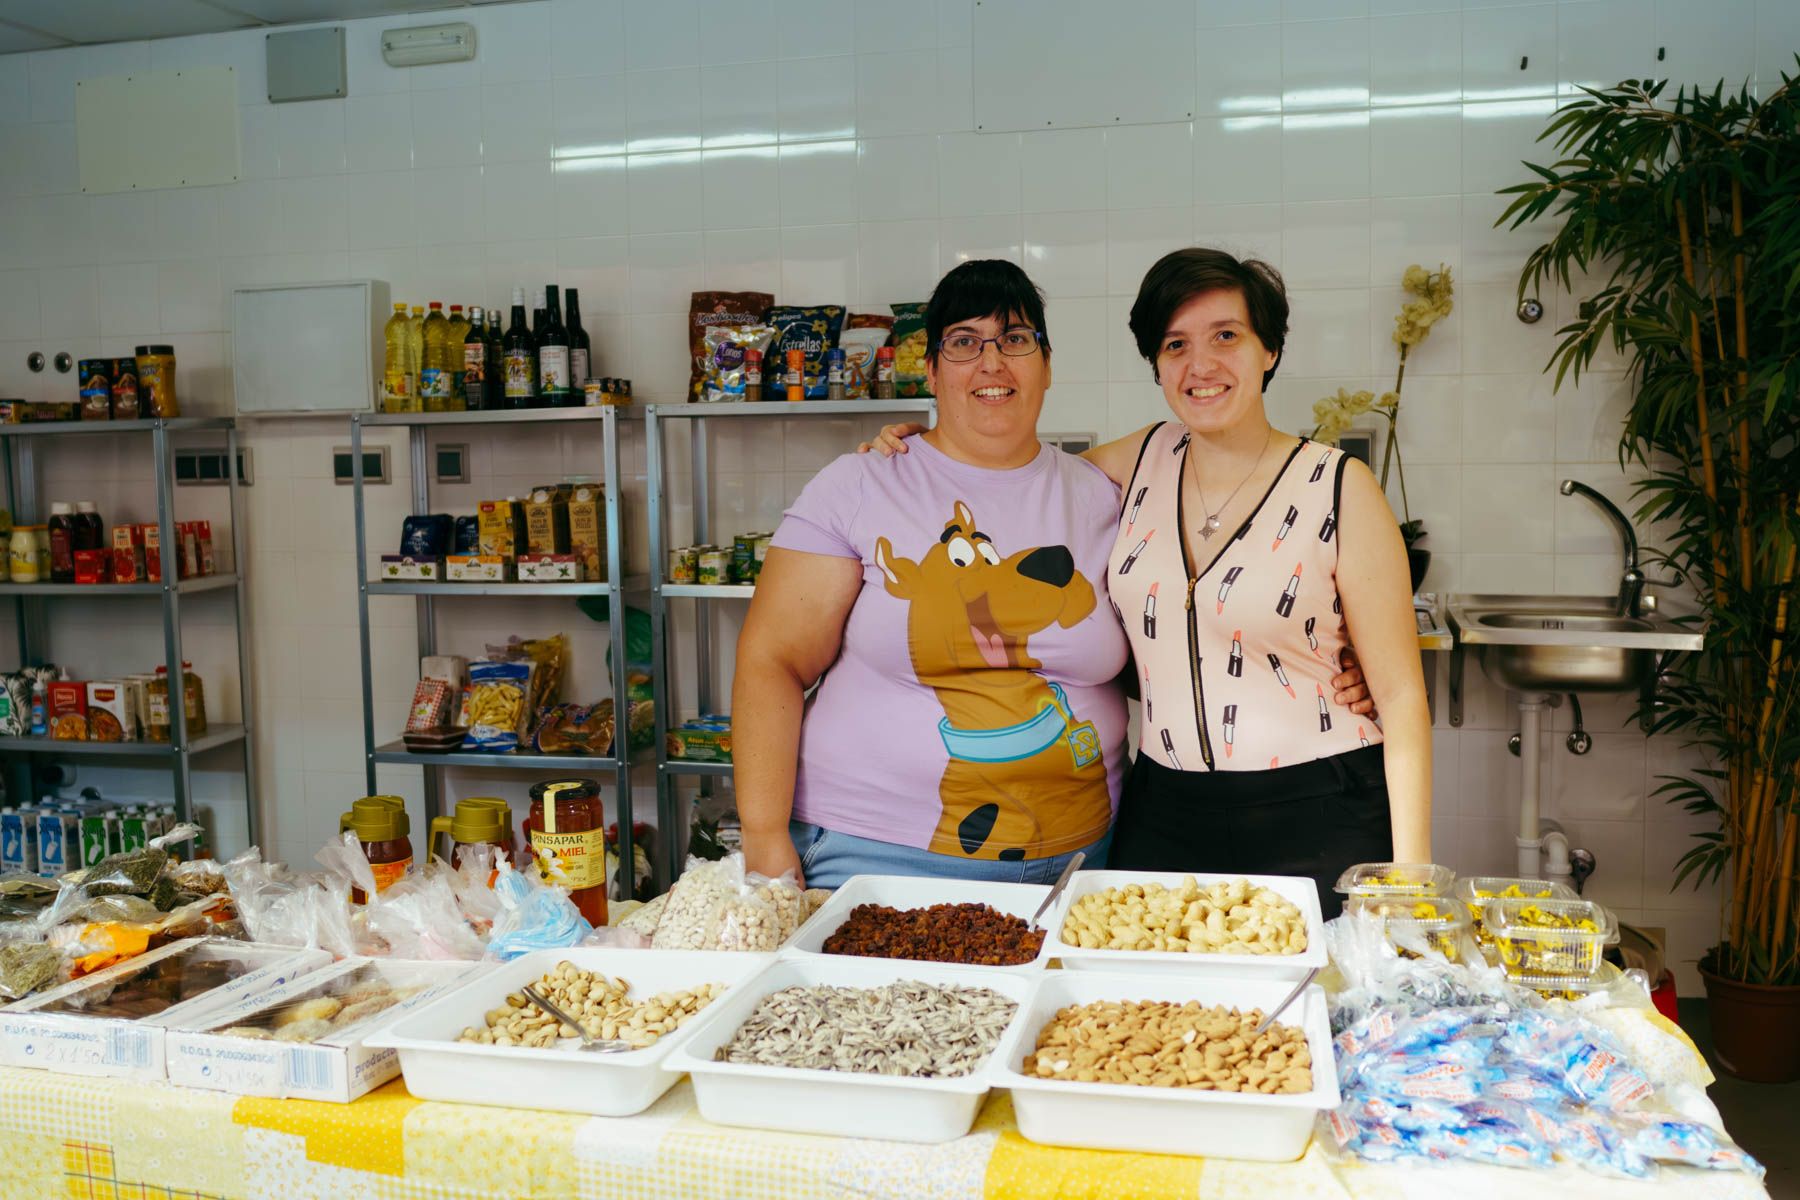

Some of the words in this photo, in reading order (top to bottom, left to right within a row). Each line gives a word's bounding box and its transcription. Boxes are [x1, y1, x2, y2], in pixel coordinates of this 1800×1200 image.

[780, 336, 822, 353] Estrellas
[532, 834, 584, 845] PINSAPAR
[559, 846, 587, 857] MIEL
